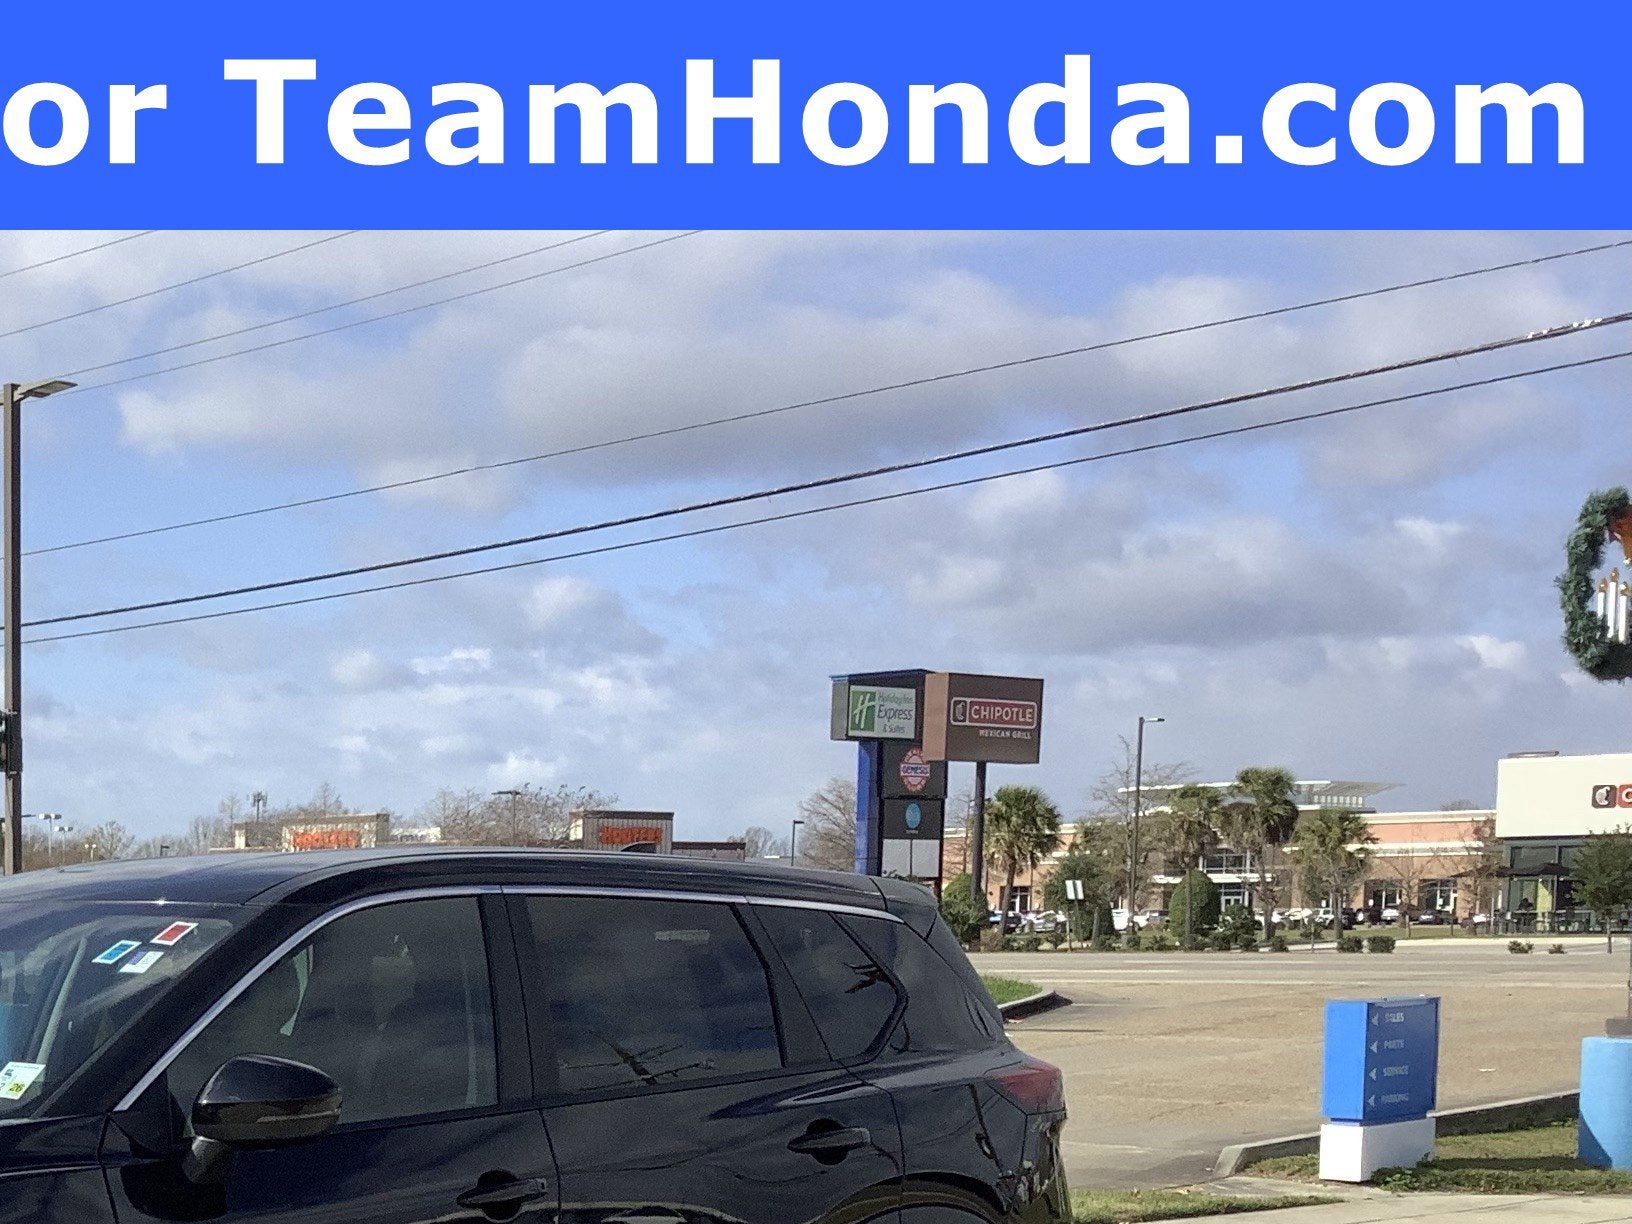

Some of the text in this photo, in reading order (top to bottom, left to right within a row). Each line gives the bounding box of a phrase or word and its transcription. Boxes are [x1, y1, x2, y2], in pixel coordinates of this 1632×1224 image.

[877, 704, 914, 722] Express
[970, 705, 1033, 722] CHIPOTLE
[9, 1083, 26, 1093] 26
